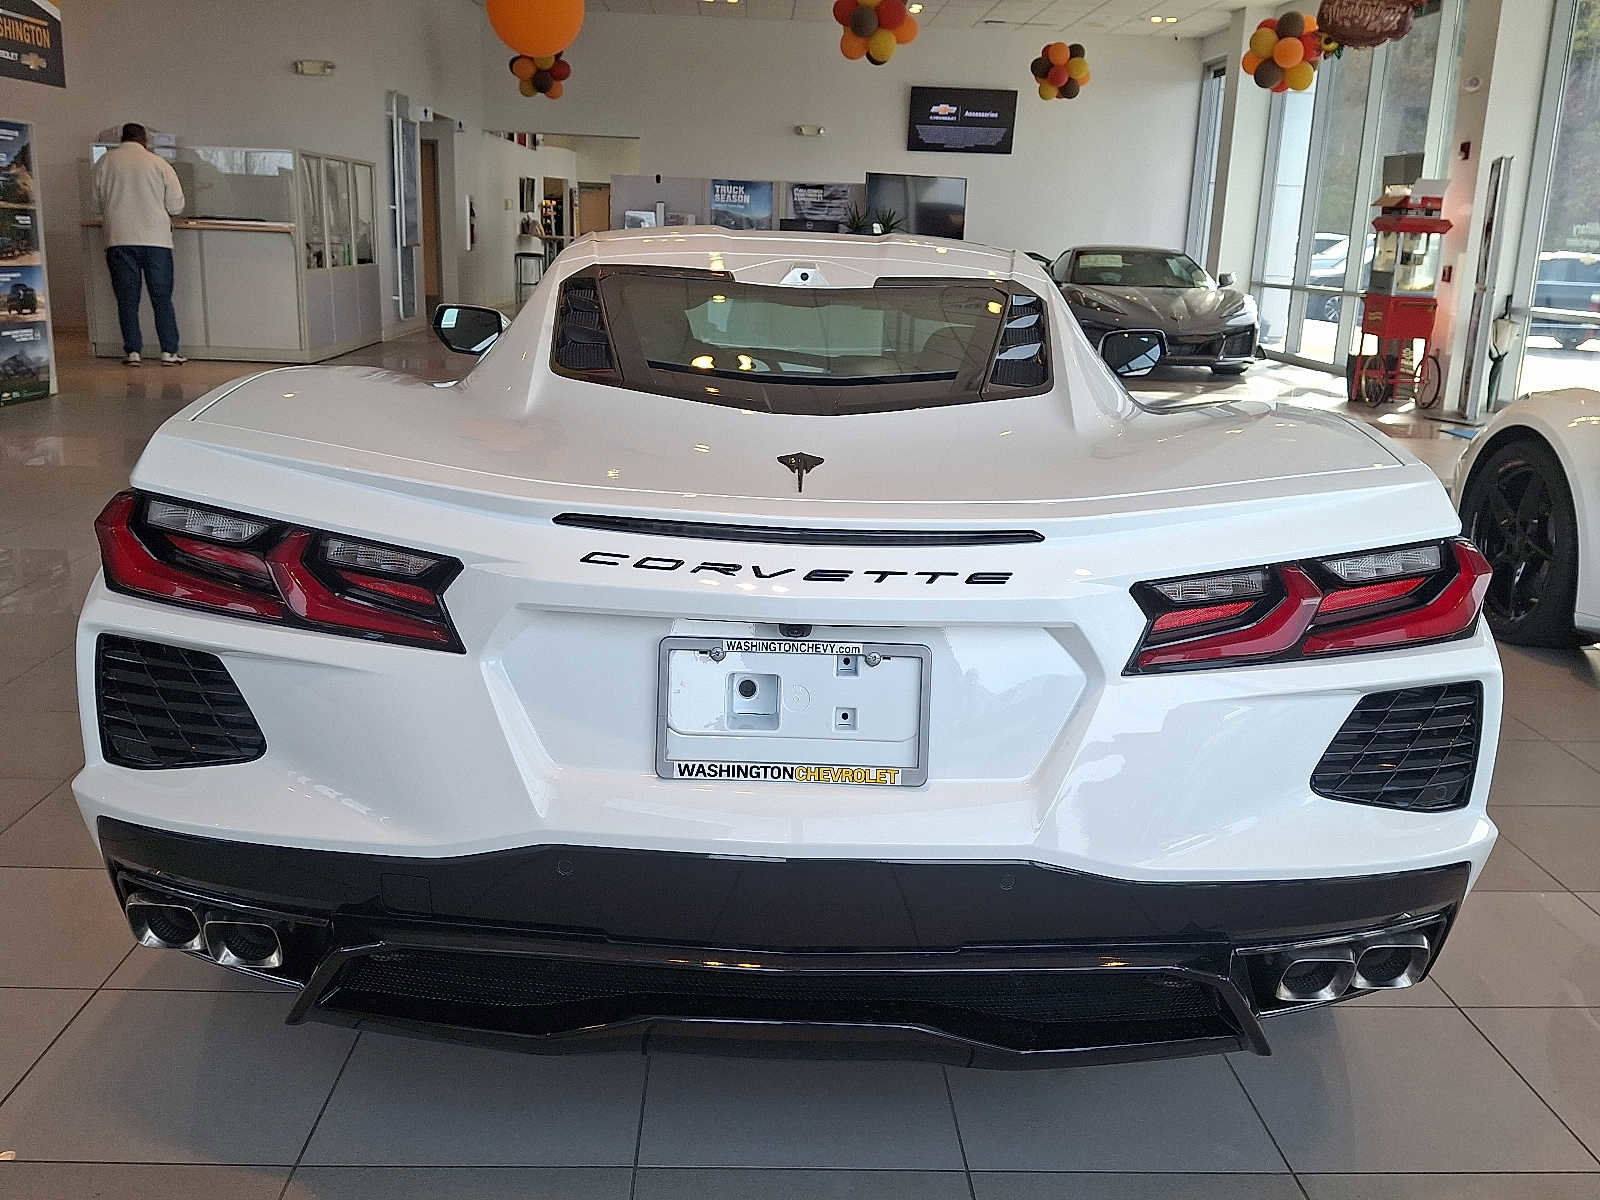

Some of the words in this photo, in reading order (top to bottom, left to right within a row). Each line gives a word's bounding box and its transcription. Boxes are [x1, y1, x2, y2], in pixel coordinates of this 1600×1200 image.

[714, 184, 746, 195] TRUCK
[714, 194, 751, 204] SEASON
[579, 551, 1014, 585] CORVETTE
[726, 640, 861, 654] WASHINGTONCHEVY.com
